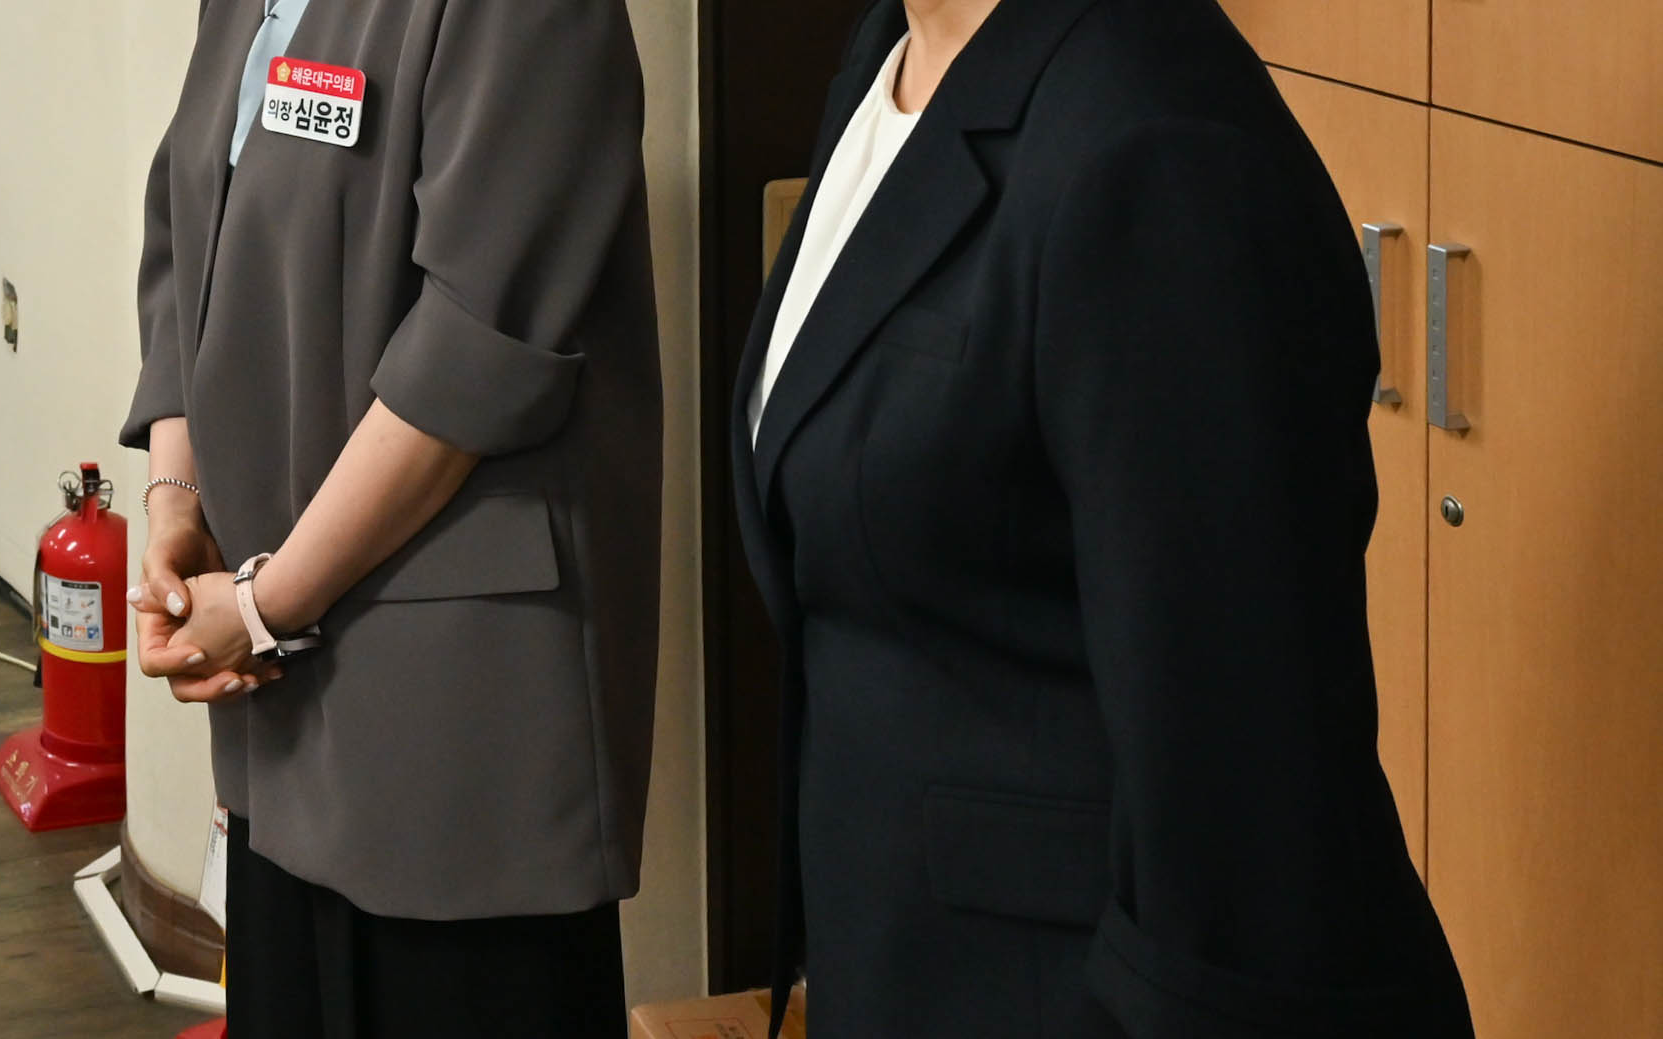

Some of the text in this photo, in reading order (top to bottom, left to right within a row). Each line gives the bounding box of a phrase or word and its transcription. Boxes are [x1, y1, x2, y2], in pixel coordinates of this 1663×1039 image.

[291, 67, 355, 95] 해운대구의회
[267, 98, 354, 139] 의장 심윤정
